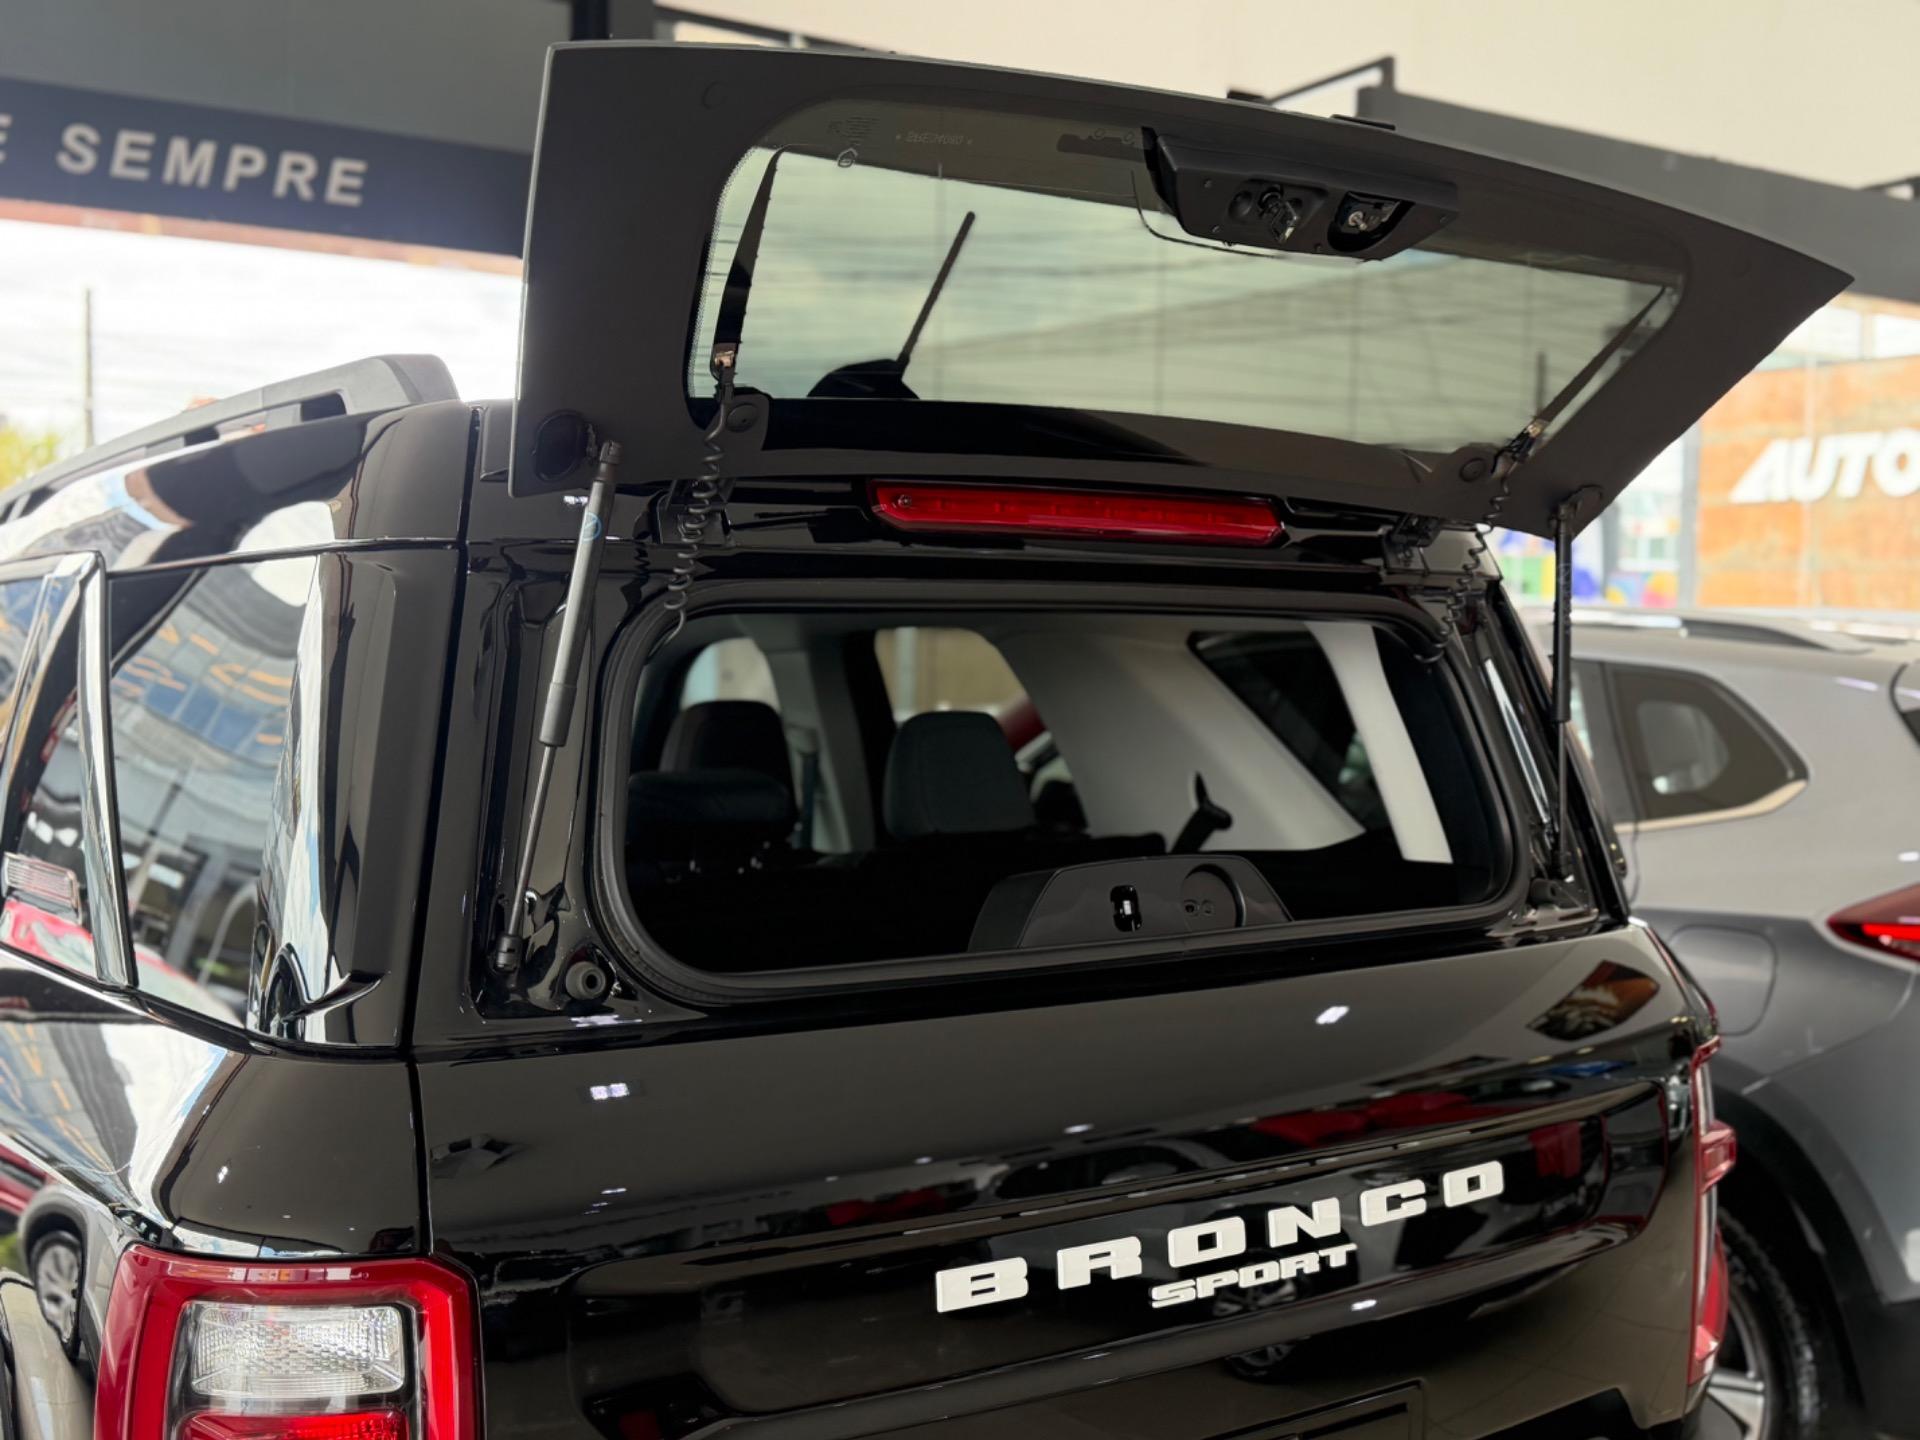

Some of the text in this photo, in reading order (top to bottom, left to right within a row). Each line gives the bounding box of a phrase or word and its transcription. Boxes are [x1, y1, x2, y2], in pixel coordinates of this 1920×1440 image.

[56, 123, 367, 206] SEMPRE
[1728, 428, 1920, 504] AUTO
[936, 1160, 1504, 1313] BRONCO
[1151, 1243, 1357, 1308] SPORT
